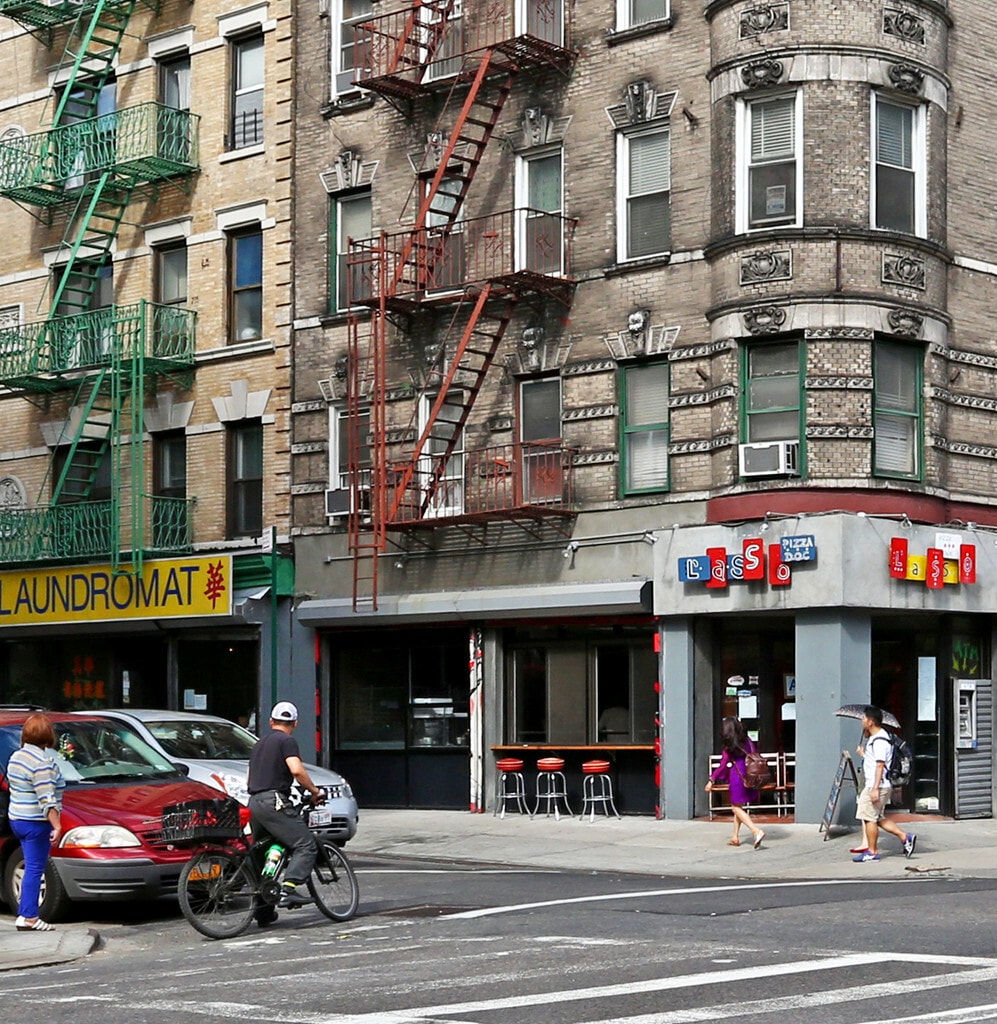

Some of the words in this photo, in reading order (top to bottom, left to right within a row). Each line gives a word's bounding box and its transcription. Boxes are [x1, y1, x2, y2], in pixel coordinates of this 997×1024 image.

[782, 537, 813, 550] PIZZA
[0, 565, 200, 616] LAUNDROMAT
[203, 559, 226, 610] 華
